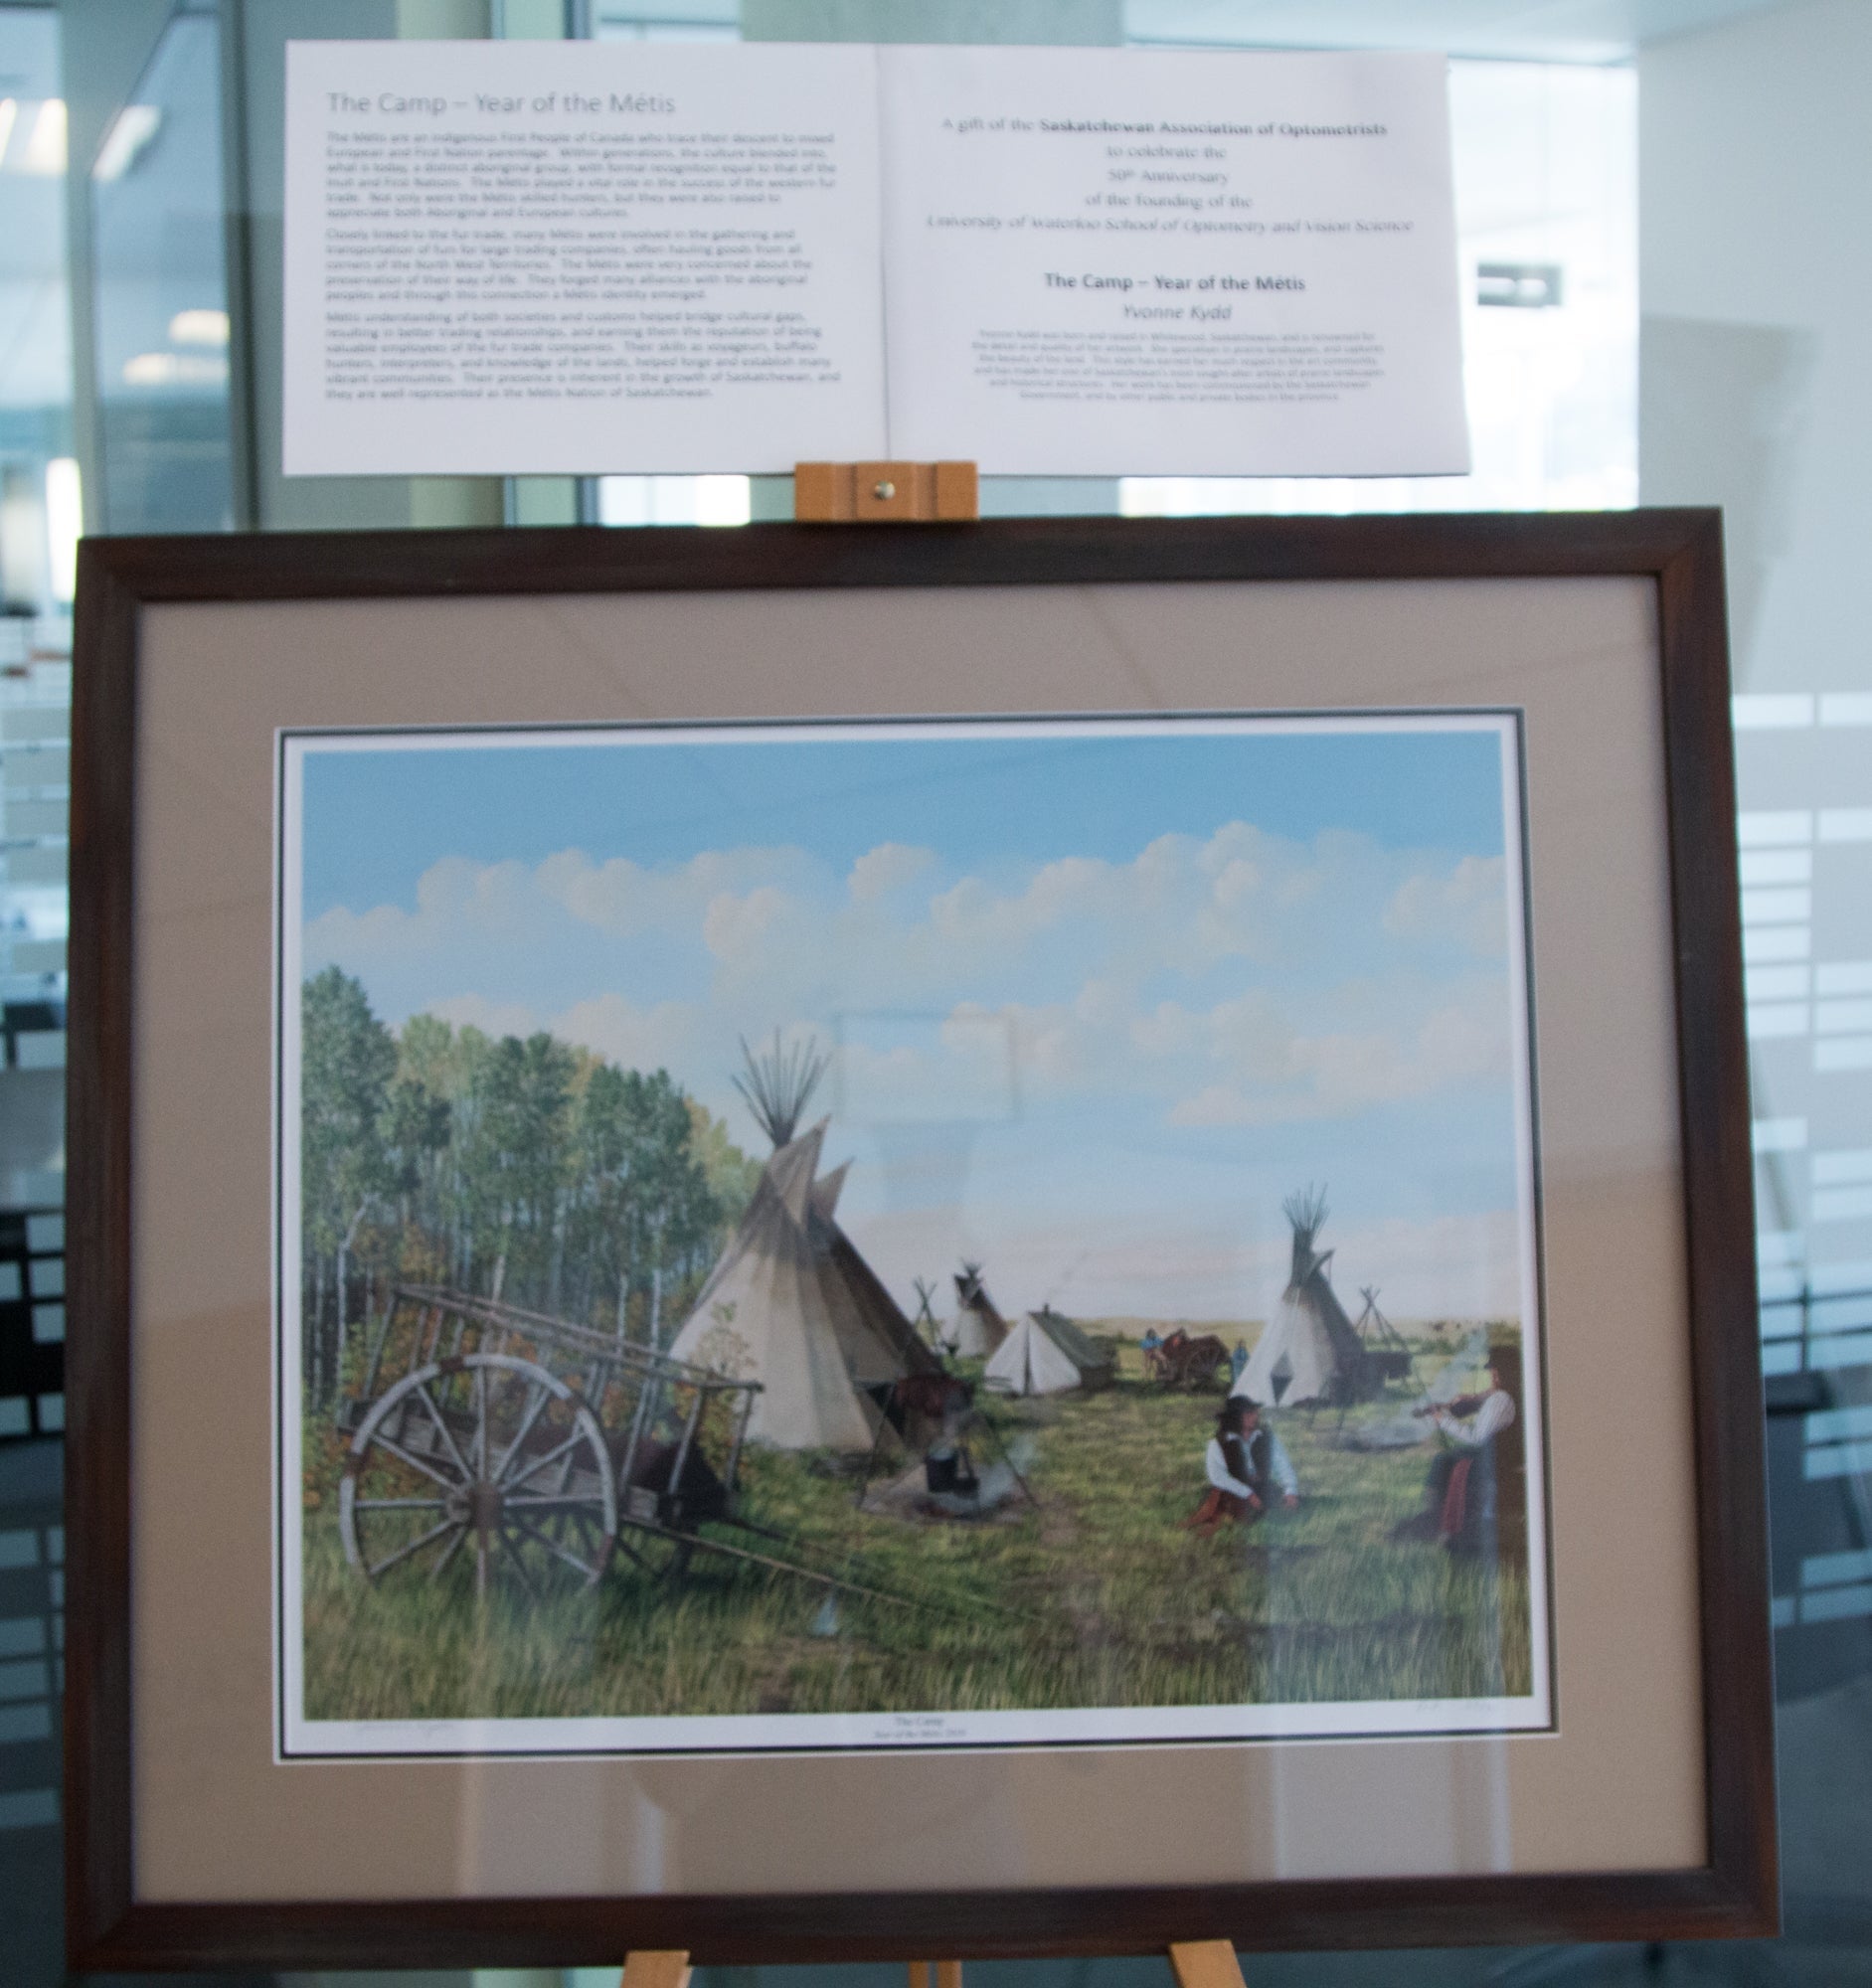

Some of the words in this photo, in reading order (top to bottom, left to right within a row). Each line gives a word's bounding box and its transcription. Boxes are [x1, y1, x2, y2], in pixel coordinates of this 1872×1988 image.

[327, 91, 372, 111] The
[377, 91, 447, 115] Camp
[474, 91, 524, 111] Year
[531, 91, 557, 111] of
[562, 91, 602, 111] the
[607, 91, 675, 111] Métis
[958, 118, 983, 132] gift
[989, 118, 1005, 130] of
[1010, 118, 1033, 131] the
[1040, 119, 1153, 132] Saskatchewan
[1159, 120, 1252, 133] Association
[1258, 121, 1275, 133] of
[1278, 122, 1387, 136] Optometrists
[1106, 145, 1123, 158] to
[1127, 146, 1198, 158] celebrate
[1203, 146, 1225, 159] the
[1141, 170, 1227, 185] Anniversary
[1086, 194, 1102, 206] of
[1107, 194, 1129, 207] the
[1135, 194, 1202, 209] founding
[1208, 195, 1224, 207] of
[1230, 195, 1251, 208] the
[1045, 273, 1078, 288] The
[1081, 273, 1134, 291] Camp
[1153, 274, 1192, 289] Year
[1196, 274, 1217, 289] of
[1219, 275, 1251, 290] the
[1253, 275, 1305, 290] Métis
[1122, 304, 1185, 318] Yvonne
[1188, 305, 1233, 321] Kydd
